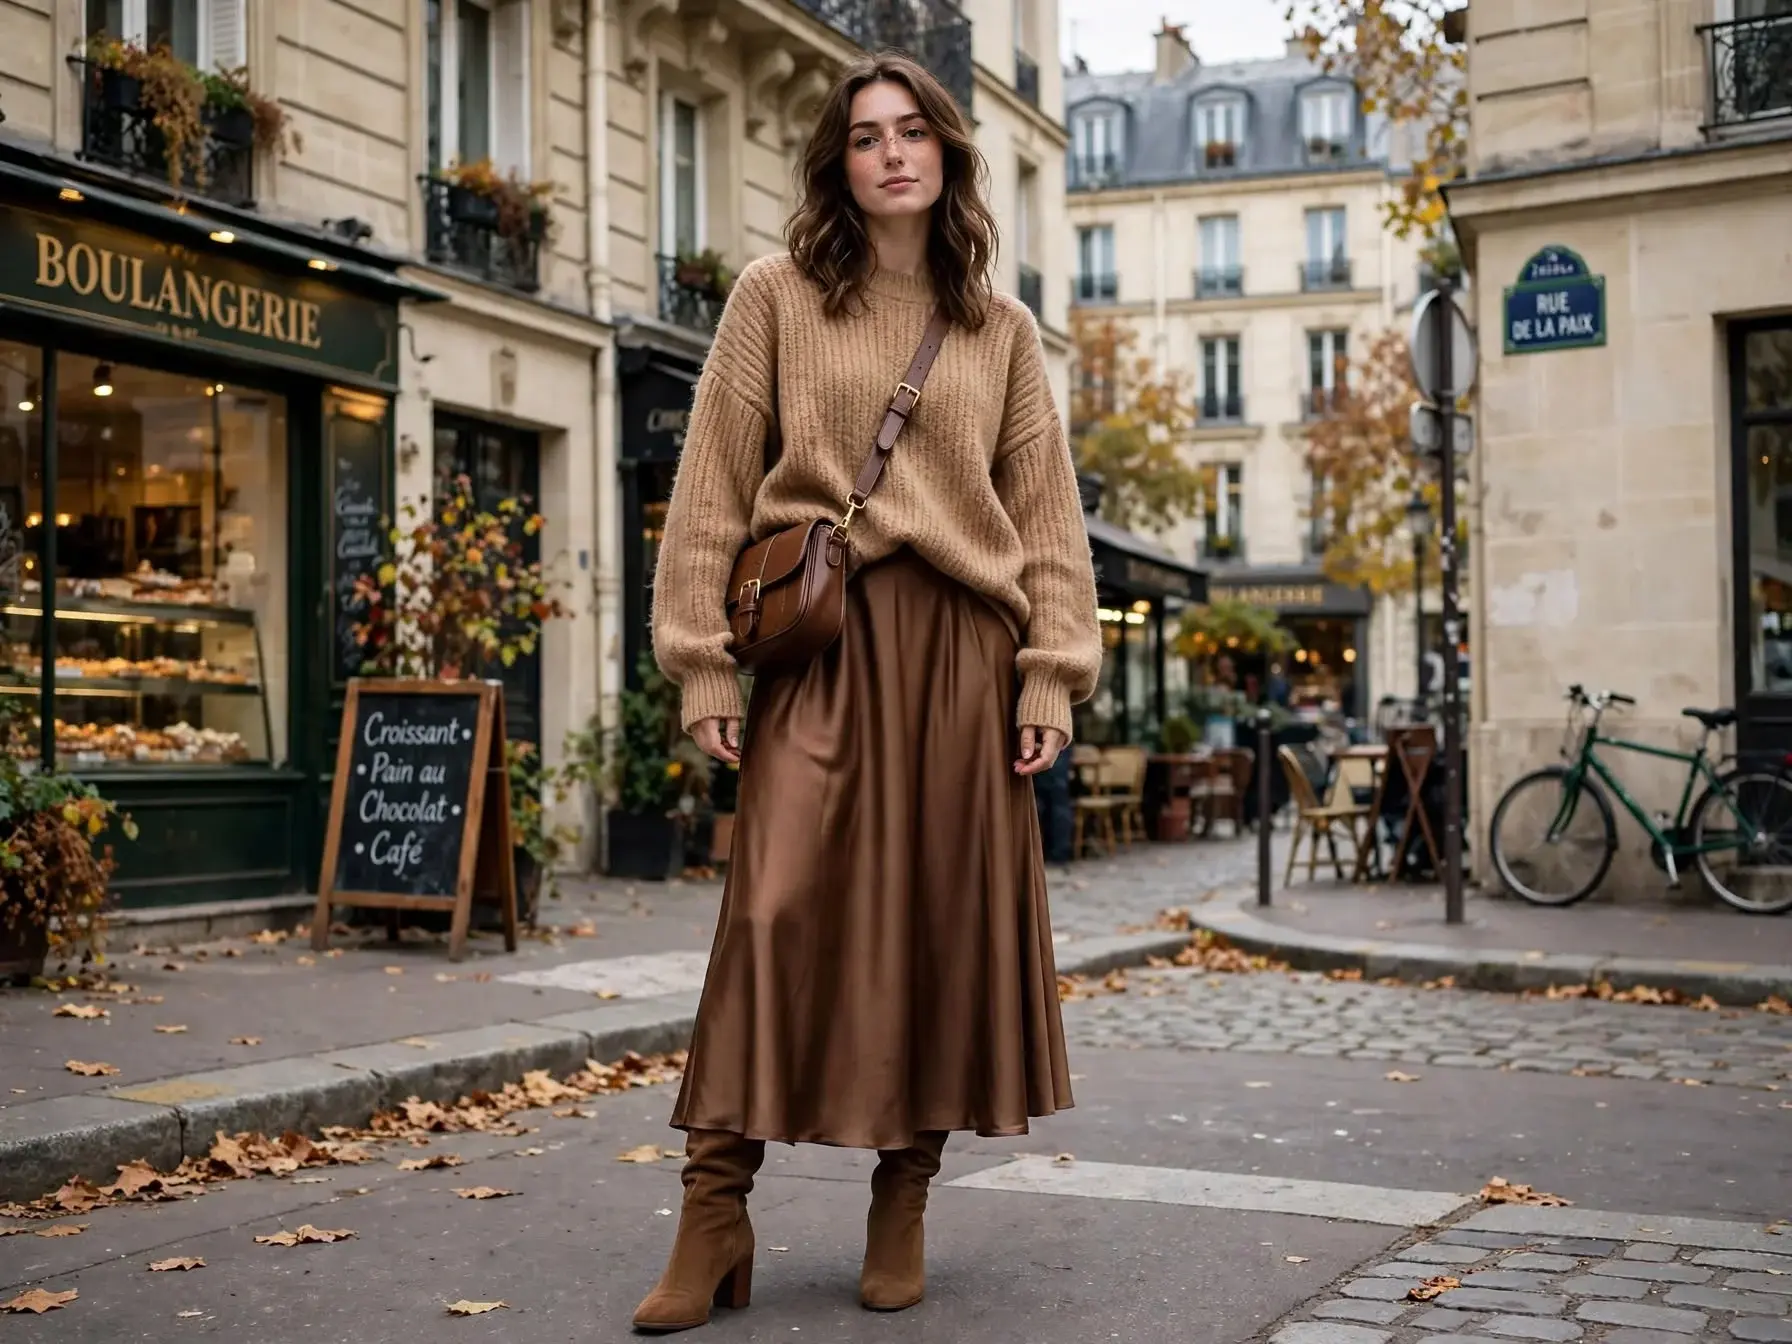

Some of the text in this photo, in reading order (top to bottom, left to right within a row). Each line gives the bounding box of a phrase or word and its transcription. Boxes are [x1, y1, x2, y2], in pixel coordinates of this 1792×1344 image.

[36, 232, 321, 349] BOULANGERIE
[1536, 291, 1570, 315] RUE
[1512, 319, 1532, 340] DE
[1535, 316, 1555, 338] LA
[364, 711, 459, 746] Croissant
[370, 751, 446, 785] Pain au
[359, 788, 448, 823] Chocolat
[370, 829, 425, 876] Café
